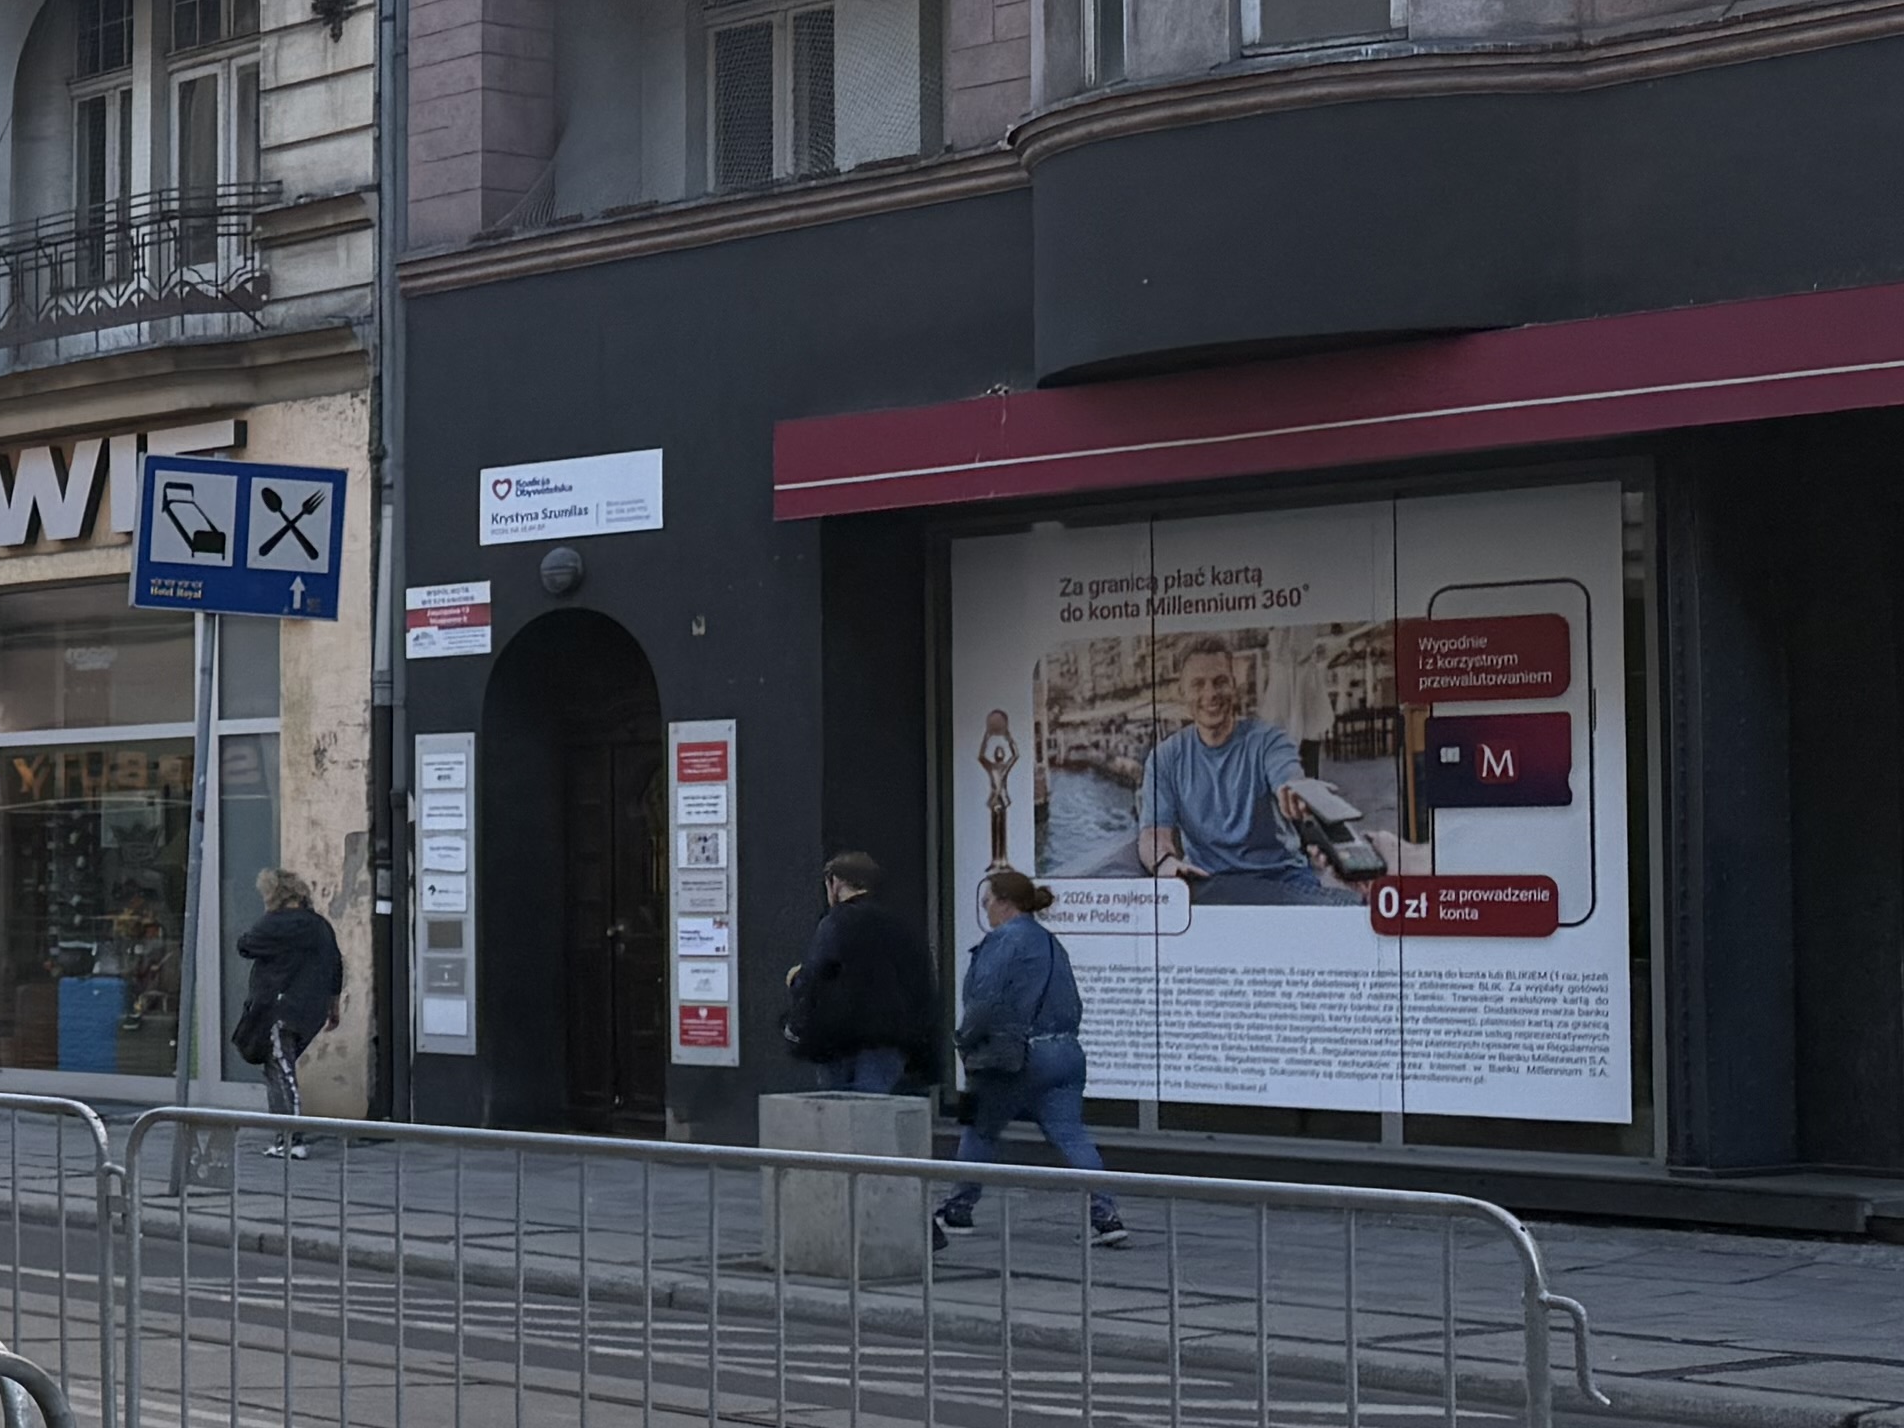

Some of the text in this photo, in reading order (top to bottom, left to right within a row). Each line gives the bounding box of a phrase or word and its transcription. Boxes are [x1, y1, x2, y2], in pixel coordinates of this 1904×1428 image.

[491, 508, 539, 527] Krystyna
[1060, 565, 1262, 599] Za granicą płać kartą
[150, 587, 202, 599] Hotel Royal
[1060, 583, 1309, 623] do konta Millennium 360°
[1419, 636, 1488, 654] Wygodnie
[1426, 659, 1434, 669] z
[1437, 653, 1518, 670] korzystnym
[1419, 671, 1552, 690] przewalutowaniem
[1481, 744, 1514, 777] M
[1064, 891, 1092, 904] 2026
[1096, 892, 1110, 904] za
[1378, 886, 1550, 918] 0 zł za prowadzenie
[1077, 913, 1087, 921] w
[1091, 909, 1130, 922] Polsce
[1439, 905, 1479, 920] konta
